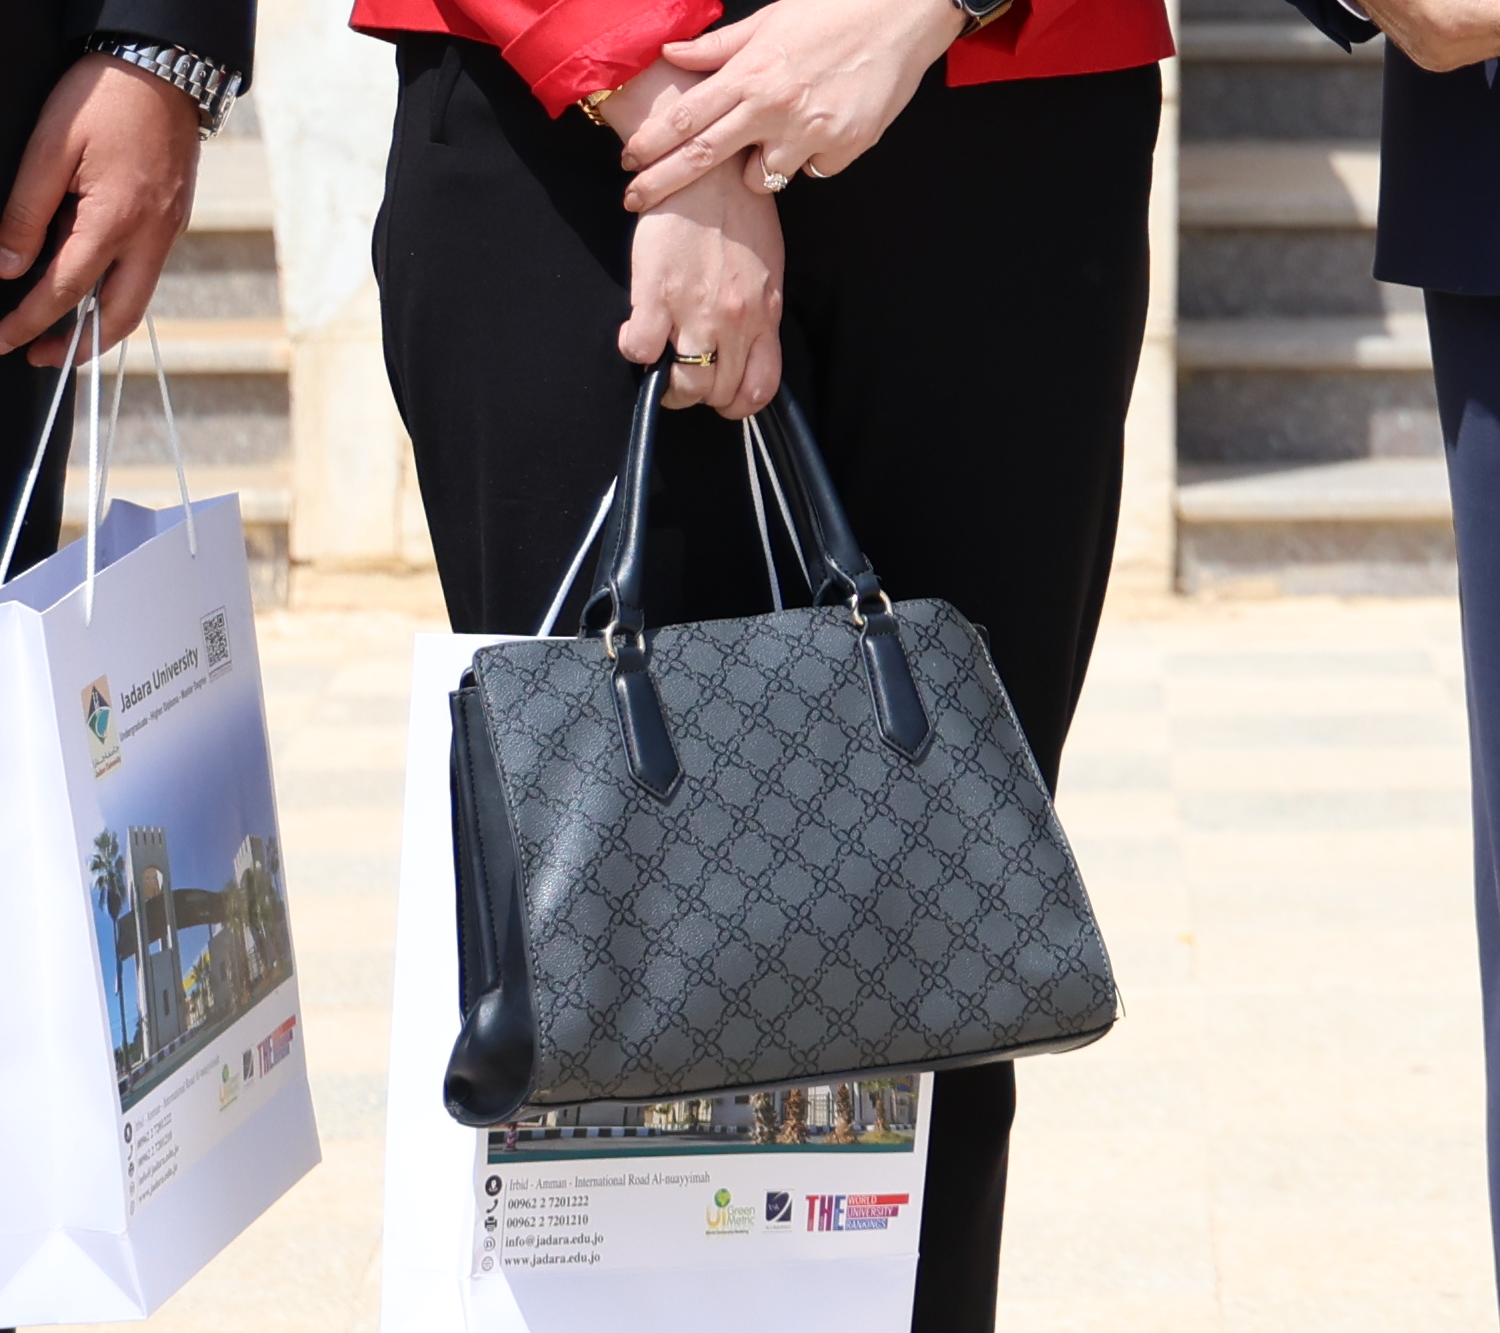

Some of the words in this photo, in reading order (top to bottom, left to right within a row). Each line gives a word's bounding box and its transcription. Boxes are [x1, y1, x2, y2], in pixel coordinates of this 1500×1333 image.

[120, 680, 152, 714] Jadara
[152, 647, 199, 691] University
[509, 1178, 529, 1191] Irbid
[536, 1178, 567, 1190] Amman
[574, 1173, 626, 1188] International
[628, 1173, 650, 1186] Road
[652, 1171, 710, 1187] Al-nuayyimah
[508, 1197, 537, 1209] 00962
[539, 1197, 546, 1209] 2
[549, 1195, 589, 1207] 7201222
[848, 1195, 877, 1206] WORLD
[727, 1205, 755, 1216] Green
[805, 1195, 846, 1232] THE
[847, 1206, 893, 1218] UNIVERSITY
[506, 1216, 536, 1229] 00962
[538, 1215, 545, 1228] 2
[548, 1214, 589, 1227] 7201210
[727, 1215, 755, 1227] Metric
[846, 1218, 886, 1230] RANKINGS
[505, 1232, 604, 1248] info@jadara.edu.jo
[504, 1251, 601, 1267] www.jadara.edu.jo
